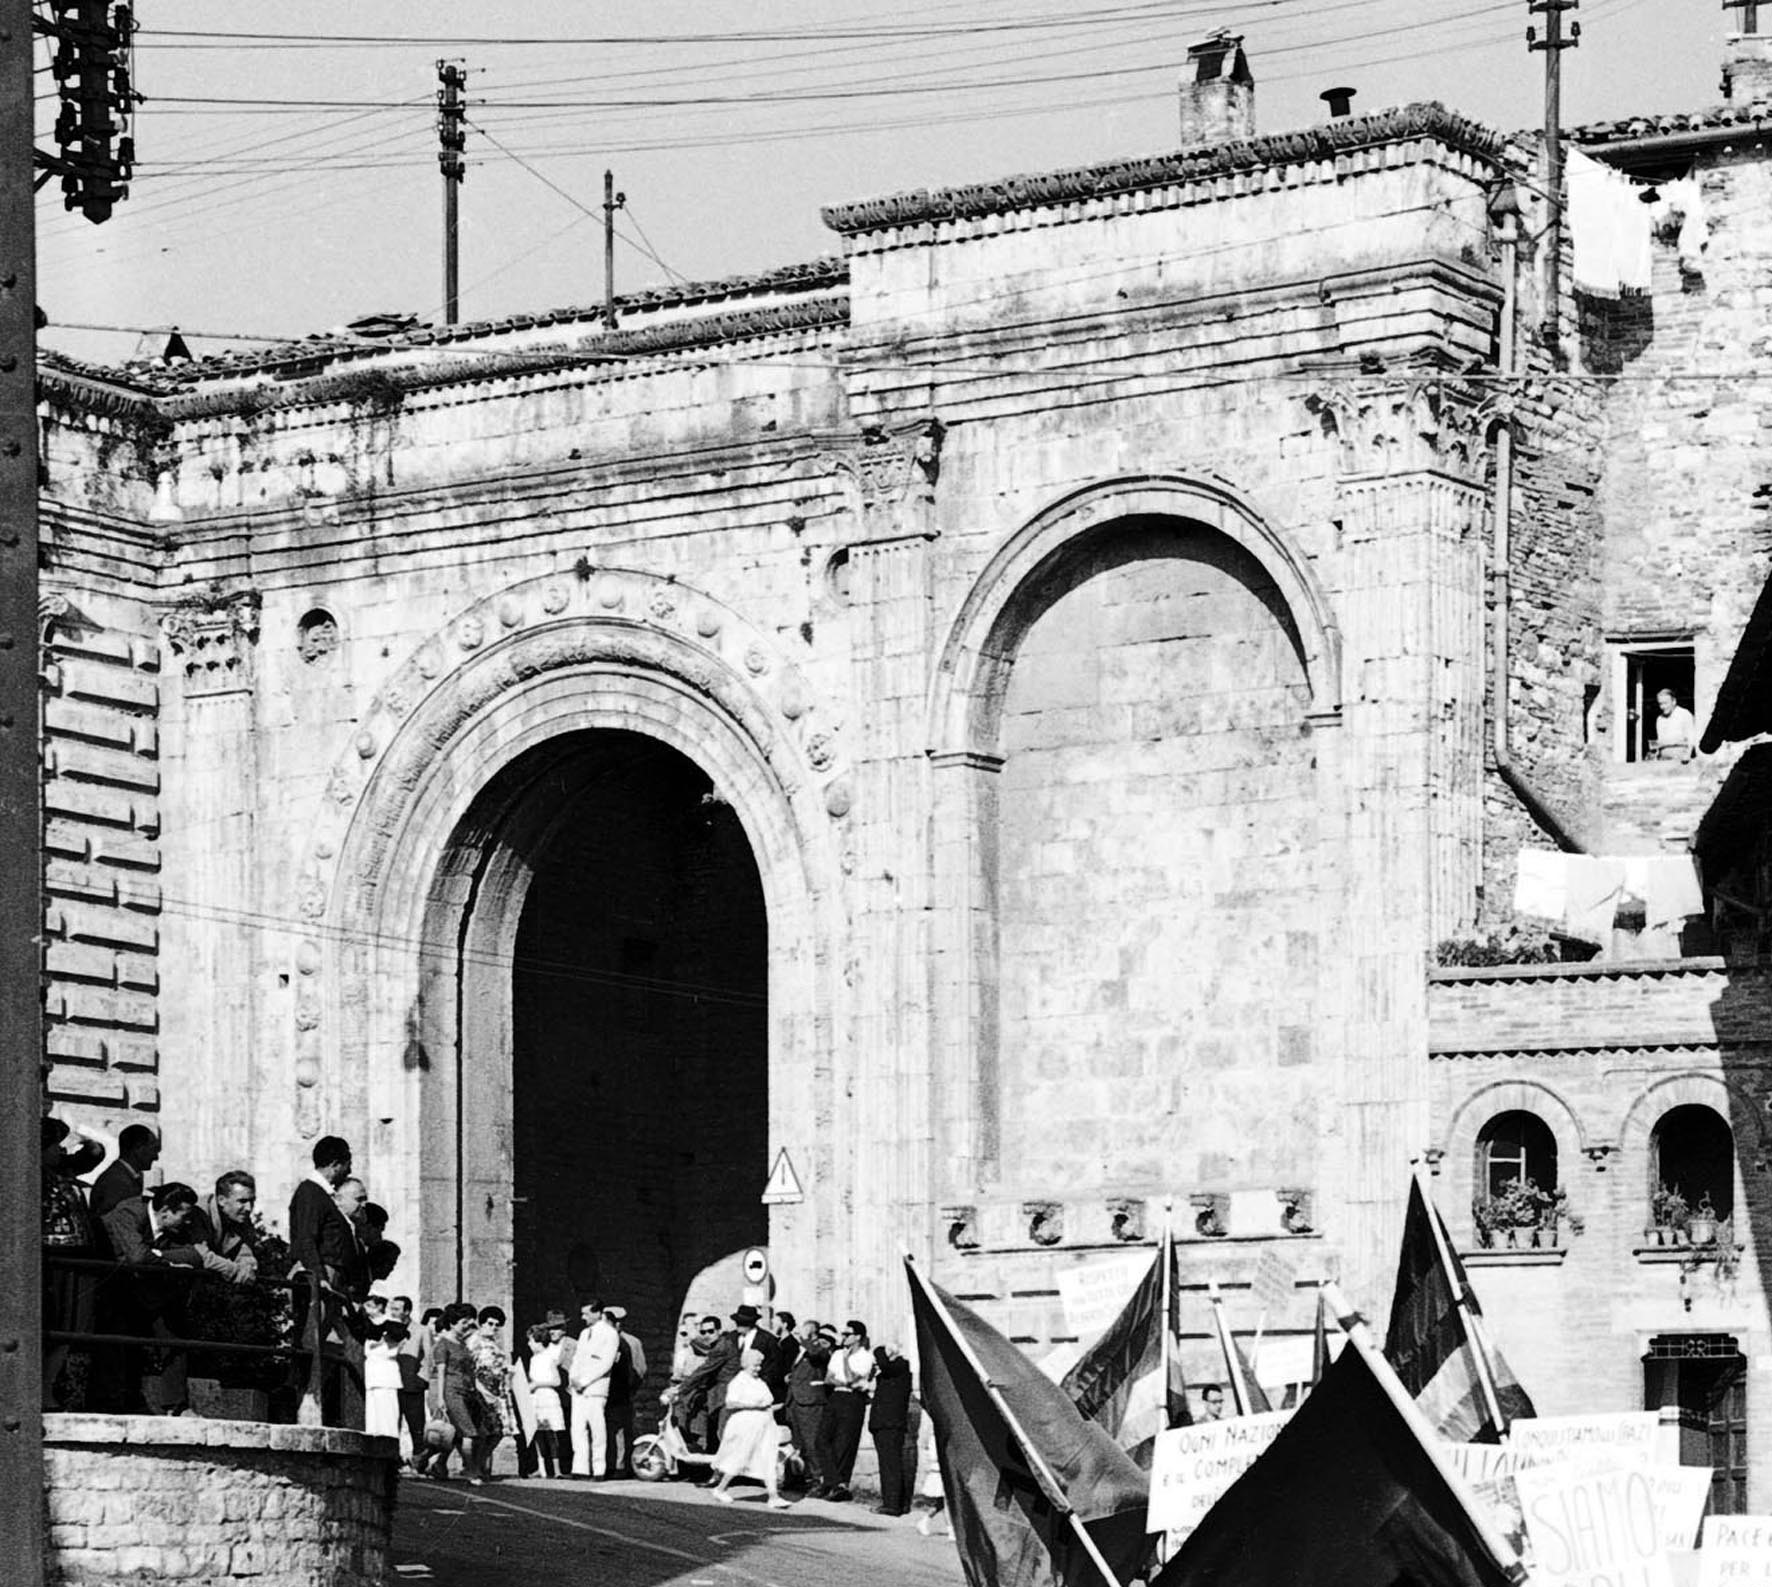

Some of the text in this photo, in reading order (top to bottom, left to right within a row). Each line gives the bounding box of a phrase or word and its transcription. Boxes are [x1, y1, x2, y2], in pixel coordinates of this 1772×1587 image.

[1532, 1472, 1657, 1575] SIAMO
[1716, 1523, 1762, 1547] PACE
[1719, 1559, 1751, 1577] PER
